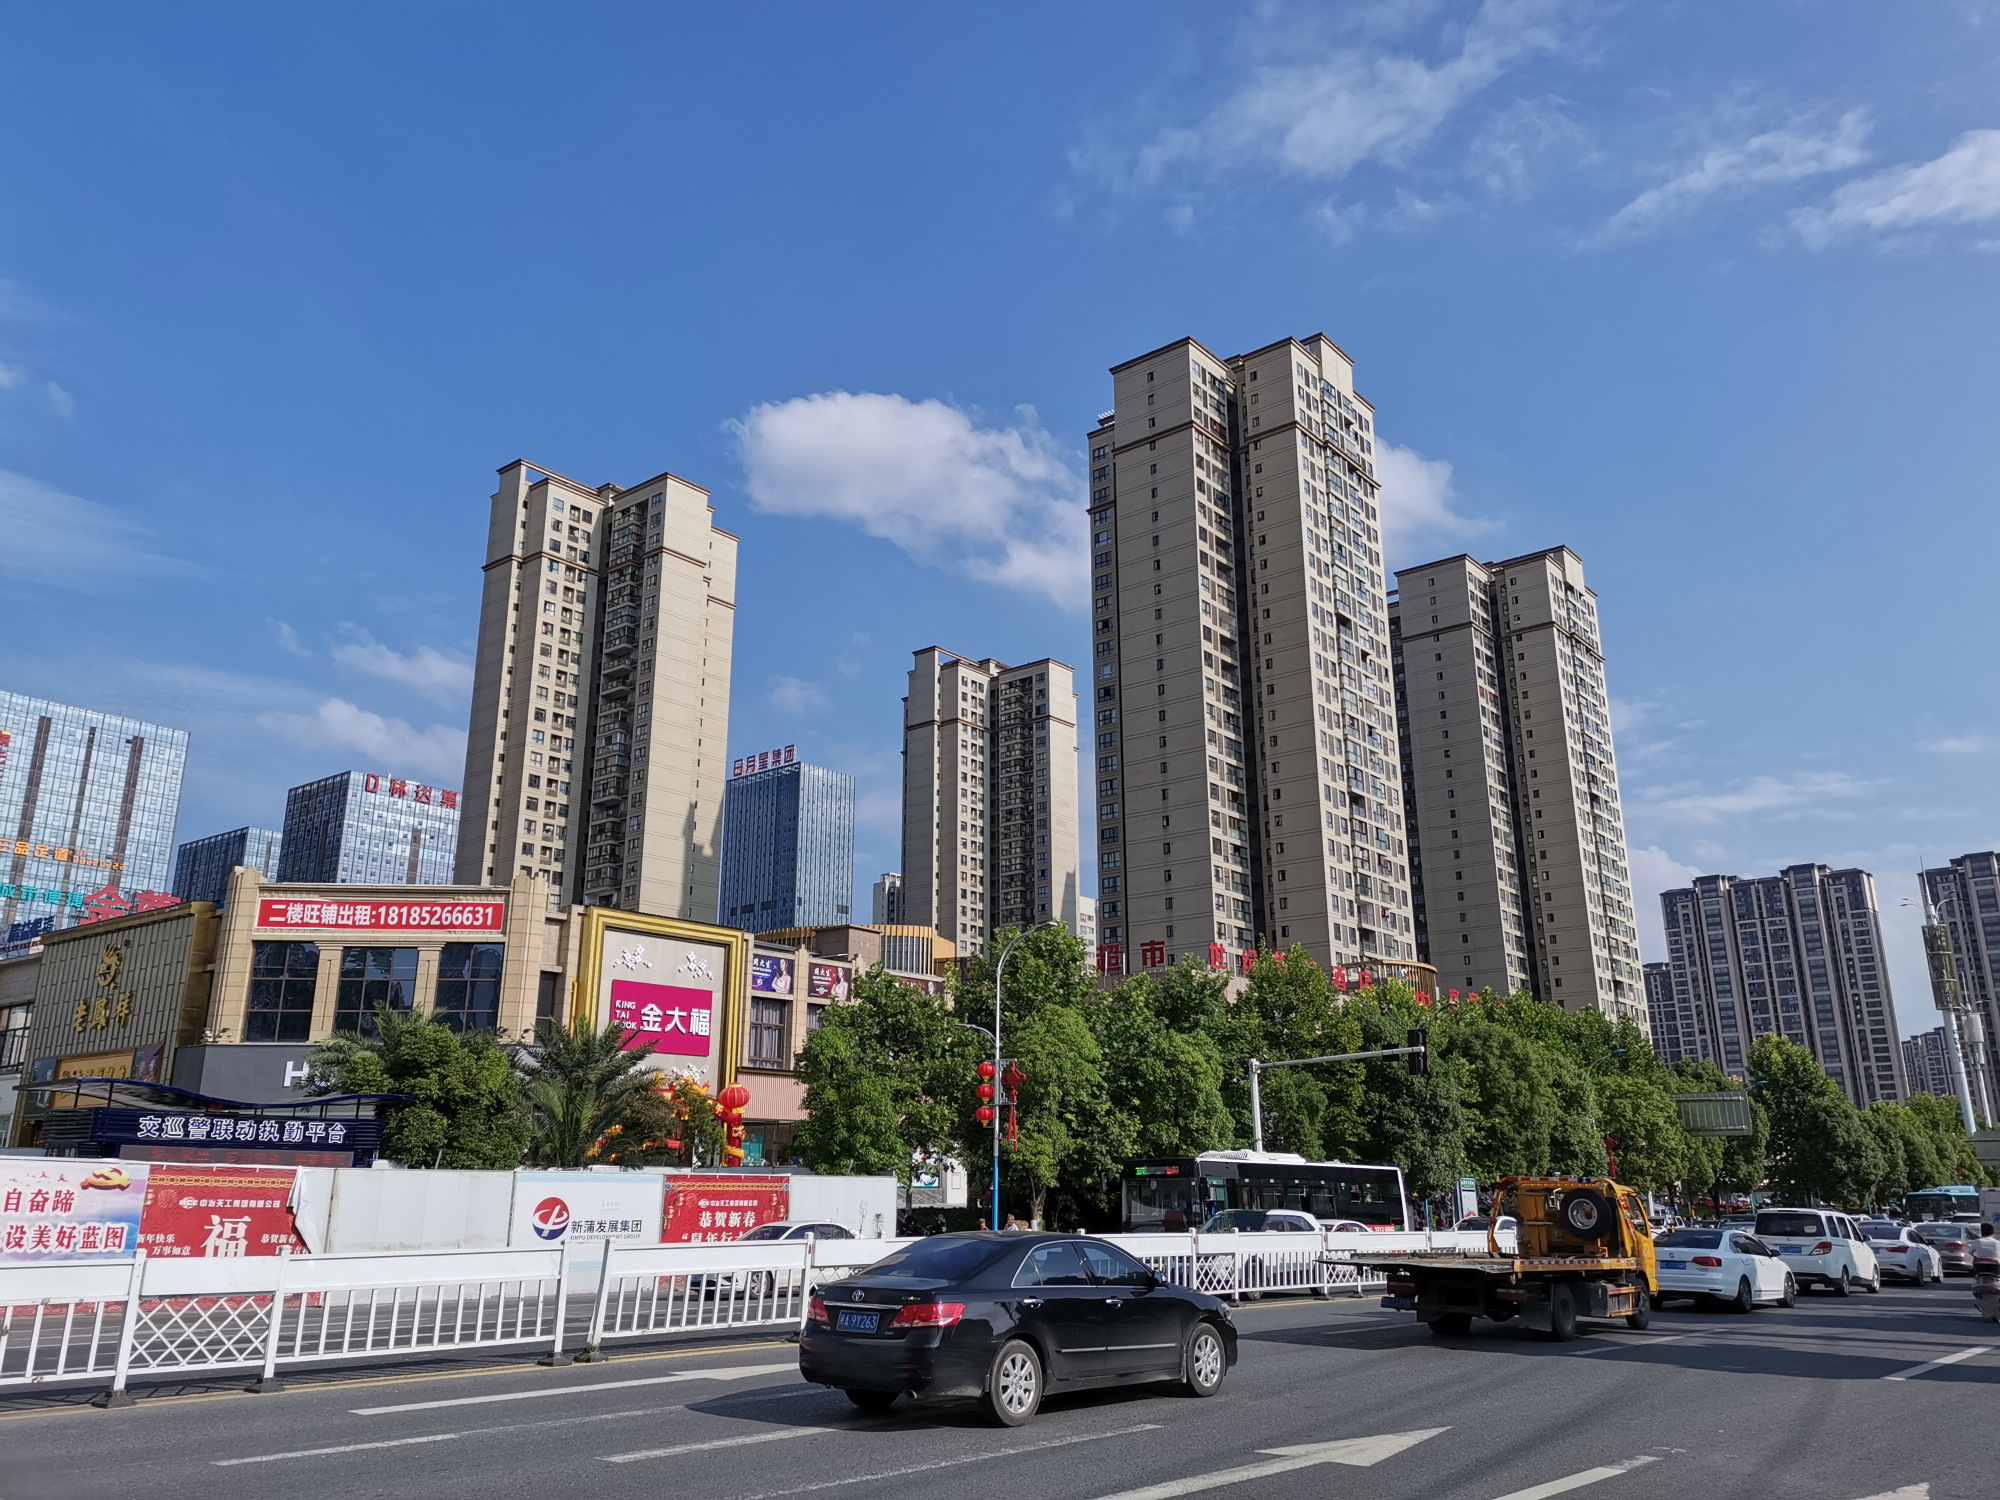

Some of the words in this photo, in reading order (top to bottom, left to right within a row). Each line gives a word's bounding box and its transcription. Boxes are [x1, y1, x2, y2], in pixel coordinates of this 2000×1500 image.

[615, 1000, 636, 1010] KING
[615, 1010, 630, 1019] TAI
[640, 1003, 711, 1037] 金大福
[137, 1115, 347, 1144] 交巡警联动执勤平台
[3, 1187, 75, 1213] 自奋蹄
[570, 1219, 642, 1234] 新蒲发展集团
[698, 1210, 756, 1228] 恭贺新春
[5, 1224, 126, 1250] 设美好蓝图
[200, 1214, 252, 1258] 福
[152, 1245, 191, 1256] 万事如意
